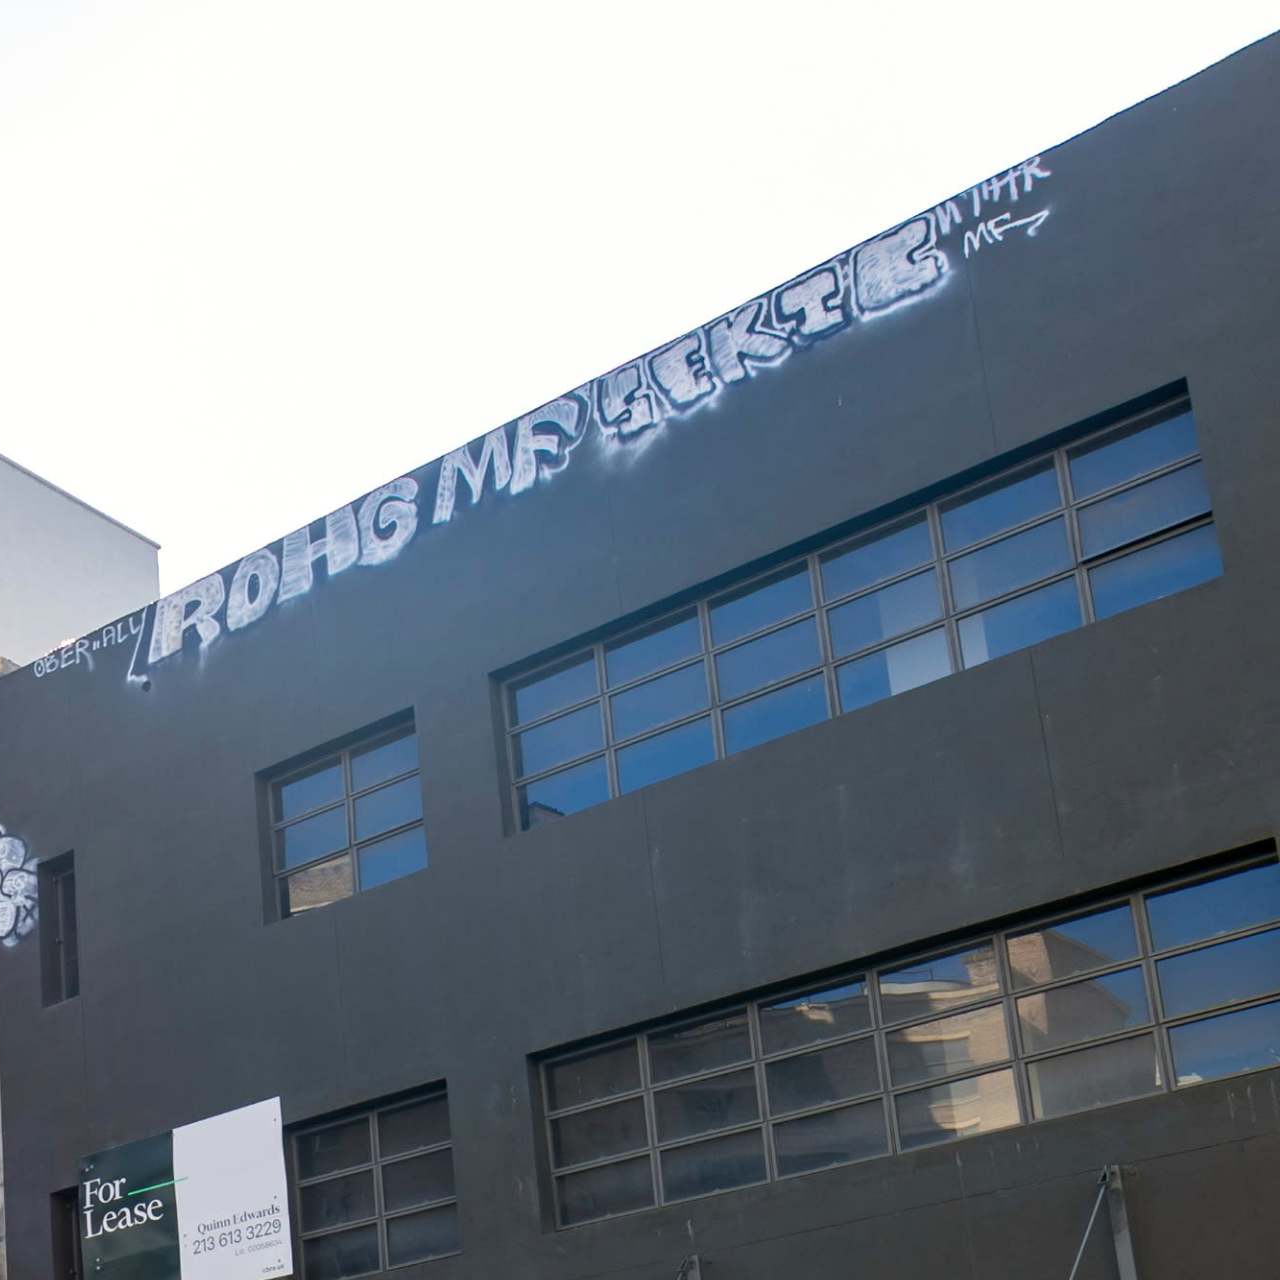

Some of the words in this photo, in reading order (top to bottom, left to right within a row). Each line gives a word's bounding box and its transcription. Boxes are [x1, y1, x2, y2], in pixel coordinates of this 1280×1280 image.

[83, 1177, 126, 1209] For
[83, 1199, 164, 1239] Lease
[197, 1218, 231, 1235] Quinn
[233, 1204, 280, 1225] Edwards
[193, 1238, 216, 1255] 213
[218, 1231, 242, 1248] 613
[246, 1218, 282, 1240] 3229
